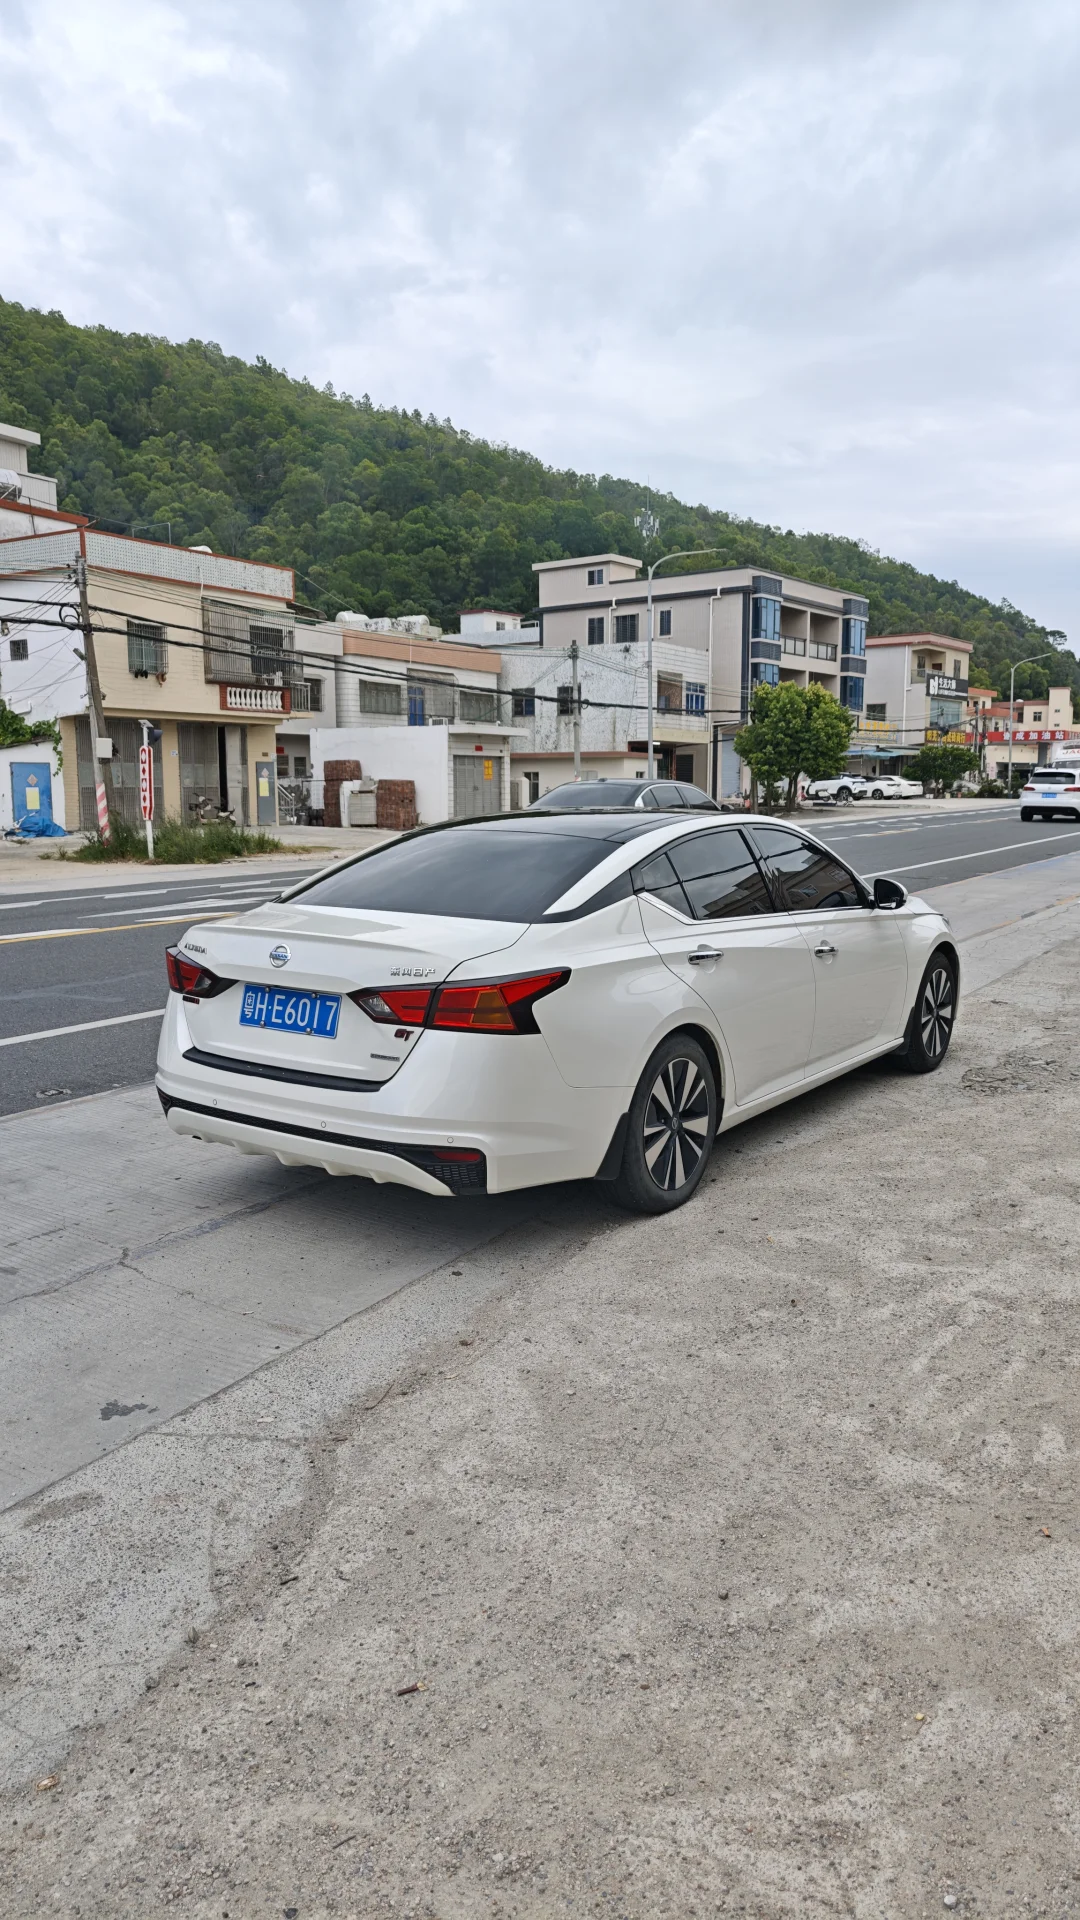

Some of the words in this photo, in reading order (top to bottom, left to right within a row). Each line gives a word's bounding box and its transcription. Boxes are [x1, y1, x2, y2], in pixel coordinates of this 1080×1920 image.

[390, 965, 436, 977] 东风日产
[394, 1028, 415, 1042] GT
